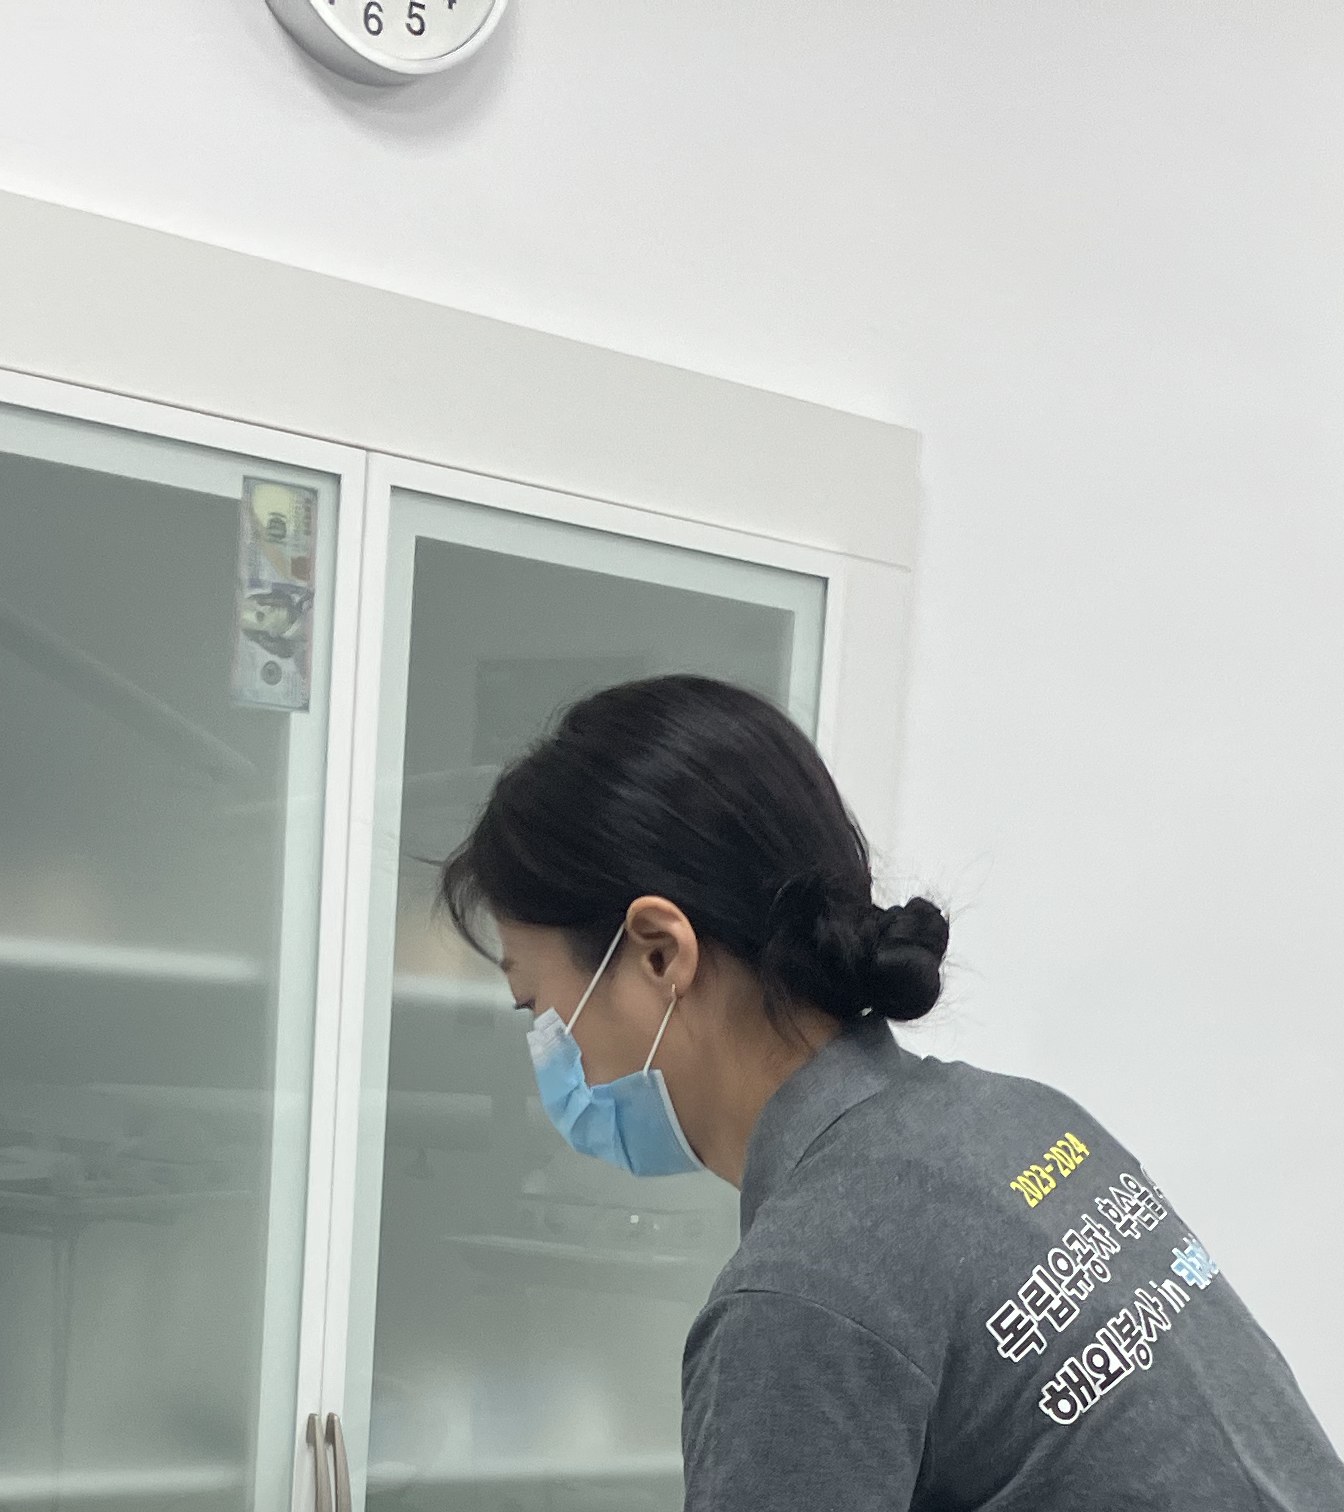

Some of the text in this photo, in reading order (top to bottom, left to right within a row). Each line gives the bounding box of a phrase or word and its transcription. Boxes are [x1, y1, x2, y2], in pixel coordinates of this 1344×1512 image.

[363, 1, 383, 36] 6
[406, 1, 425, 36] 5
[1010, 1132, 1090, 1208] 2023-2024
[986, 1214, 1121, 1363] 독립유공자
[1039, 1279, 1191, 1426] 해외봉사 in
